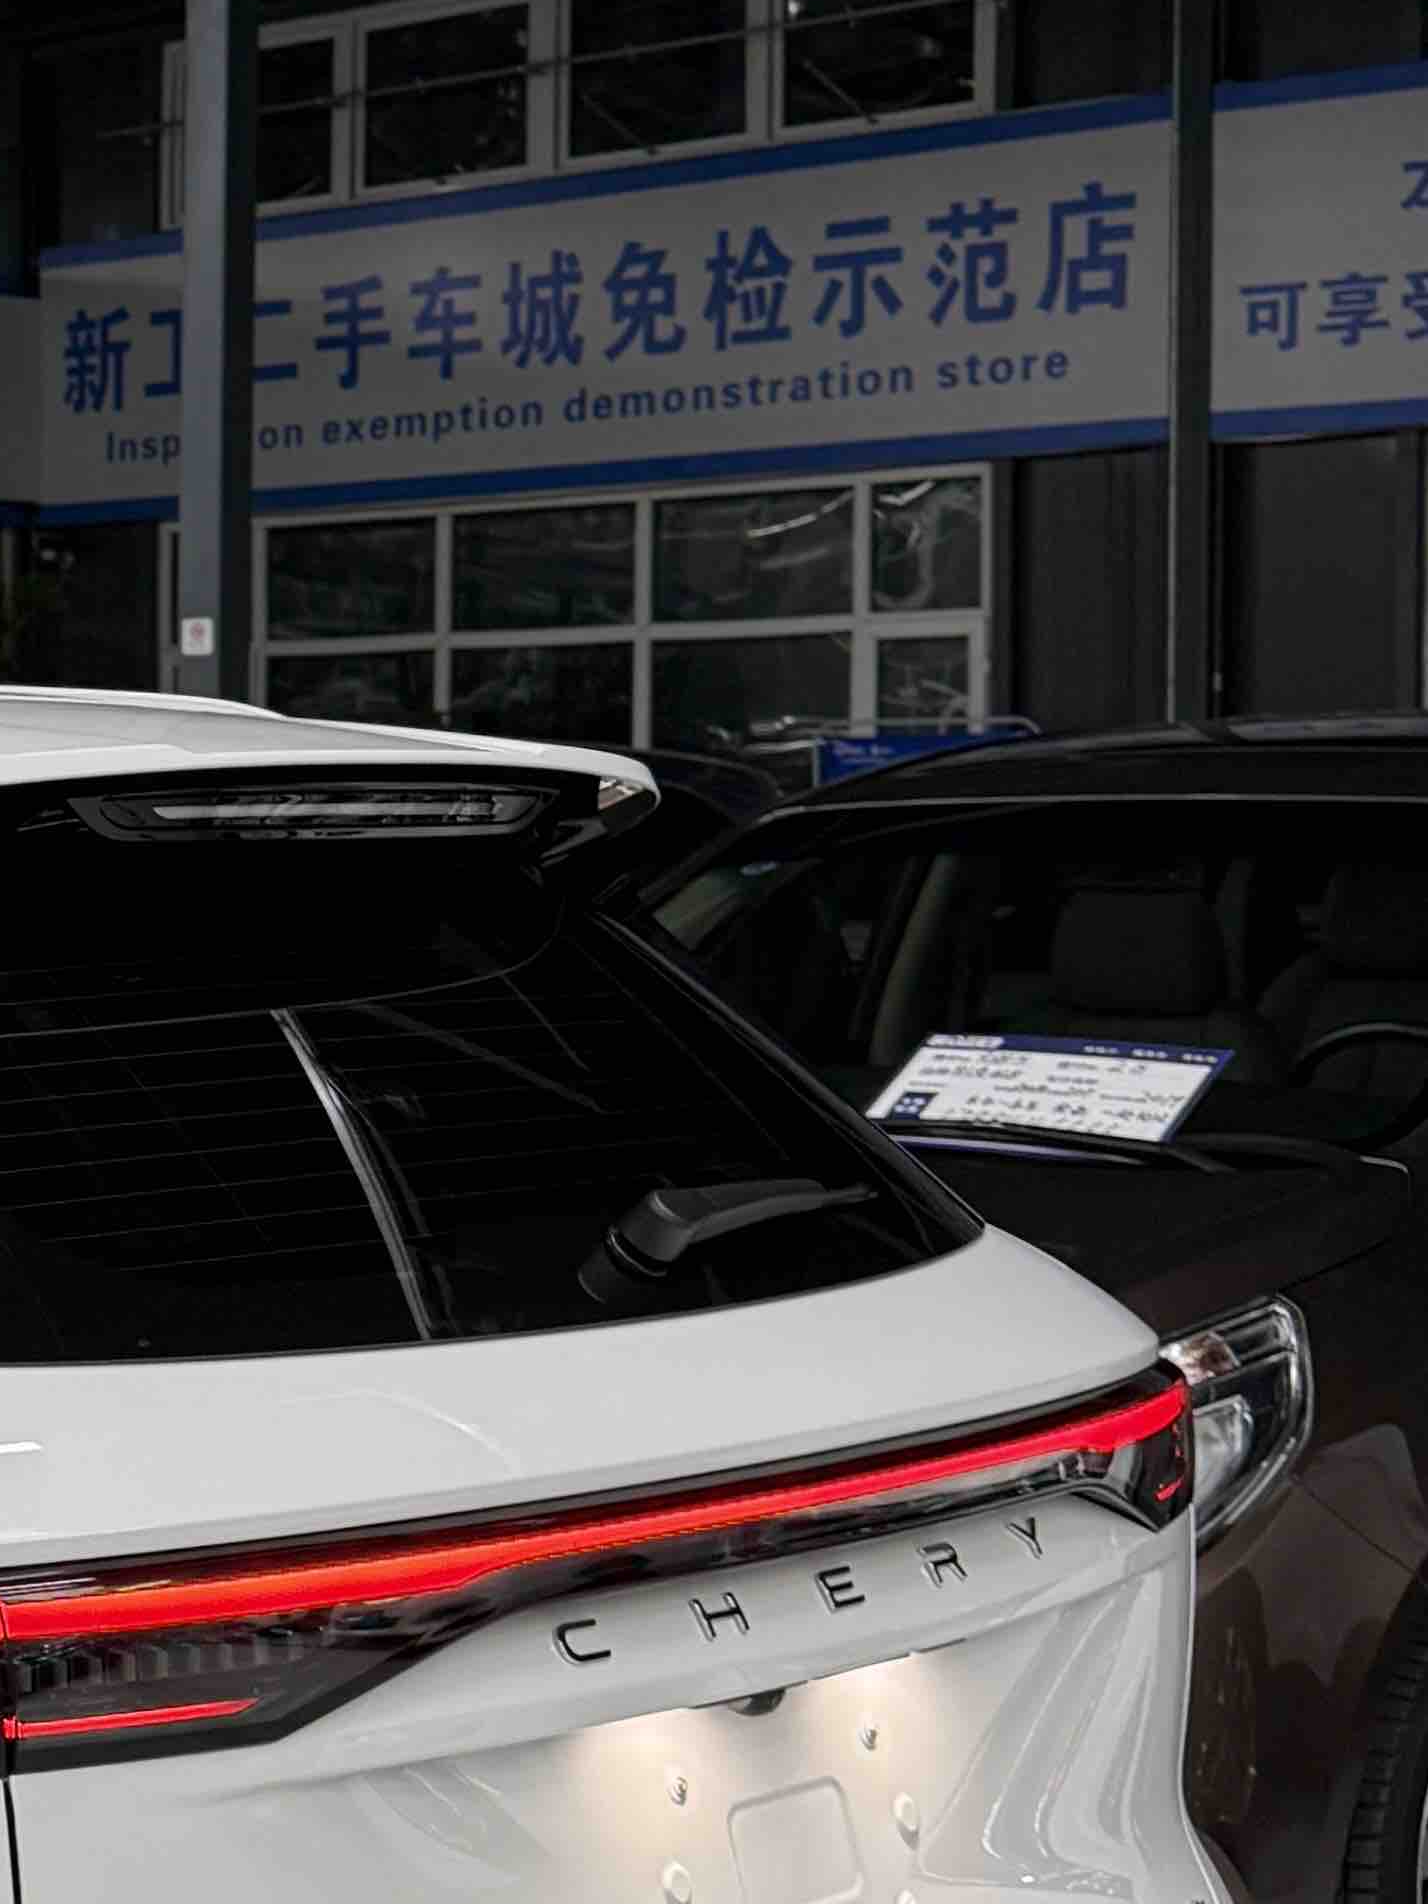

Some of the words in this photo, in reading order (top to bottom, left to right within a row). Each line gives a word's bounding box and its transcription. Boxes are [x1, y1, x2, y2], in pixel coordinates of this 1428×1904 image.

[106, 420, 305, 464] Inspon
[321, 397, 543, 444] exemption
[563, 361, 914, 424] demonstration
[937, 349, 1070, 390] store
[551, 1515, 1046, 1665] CHERY
